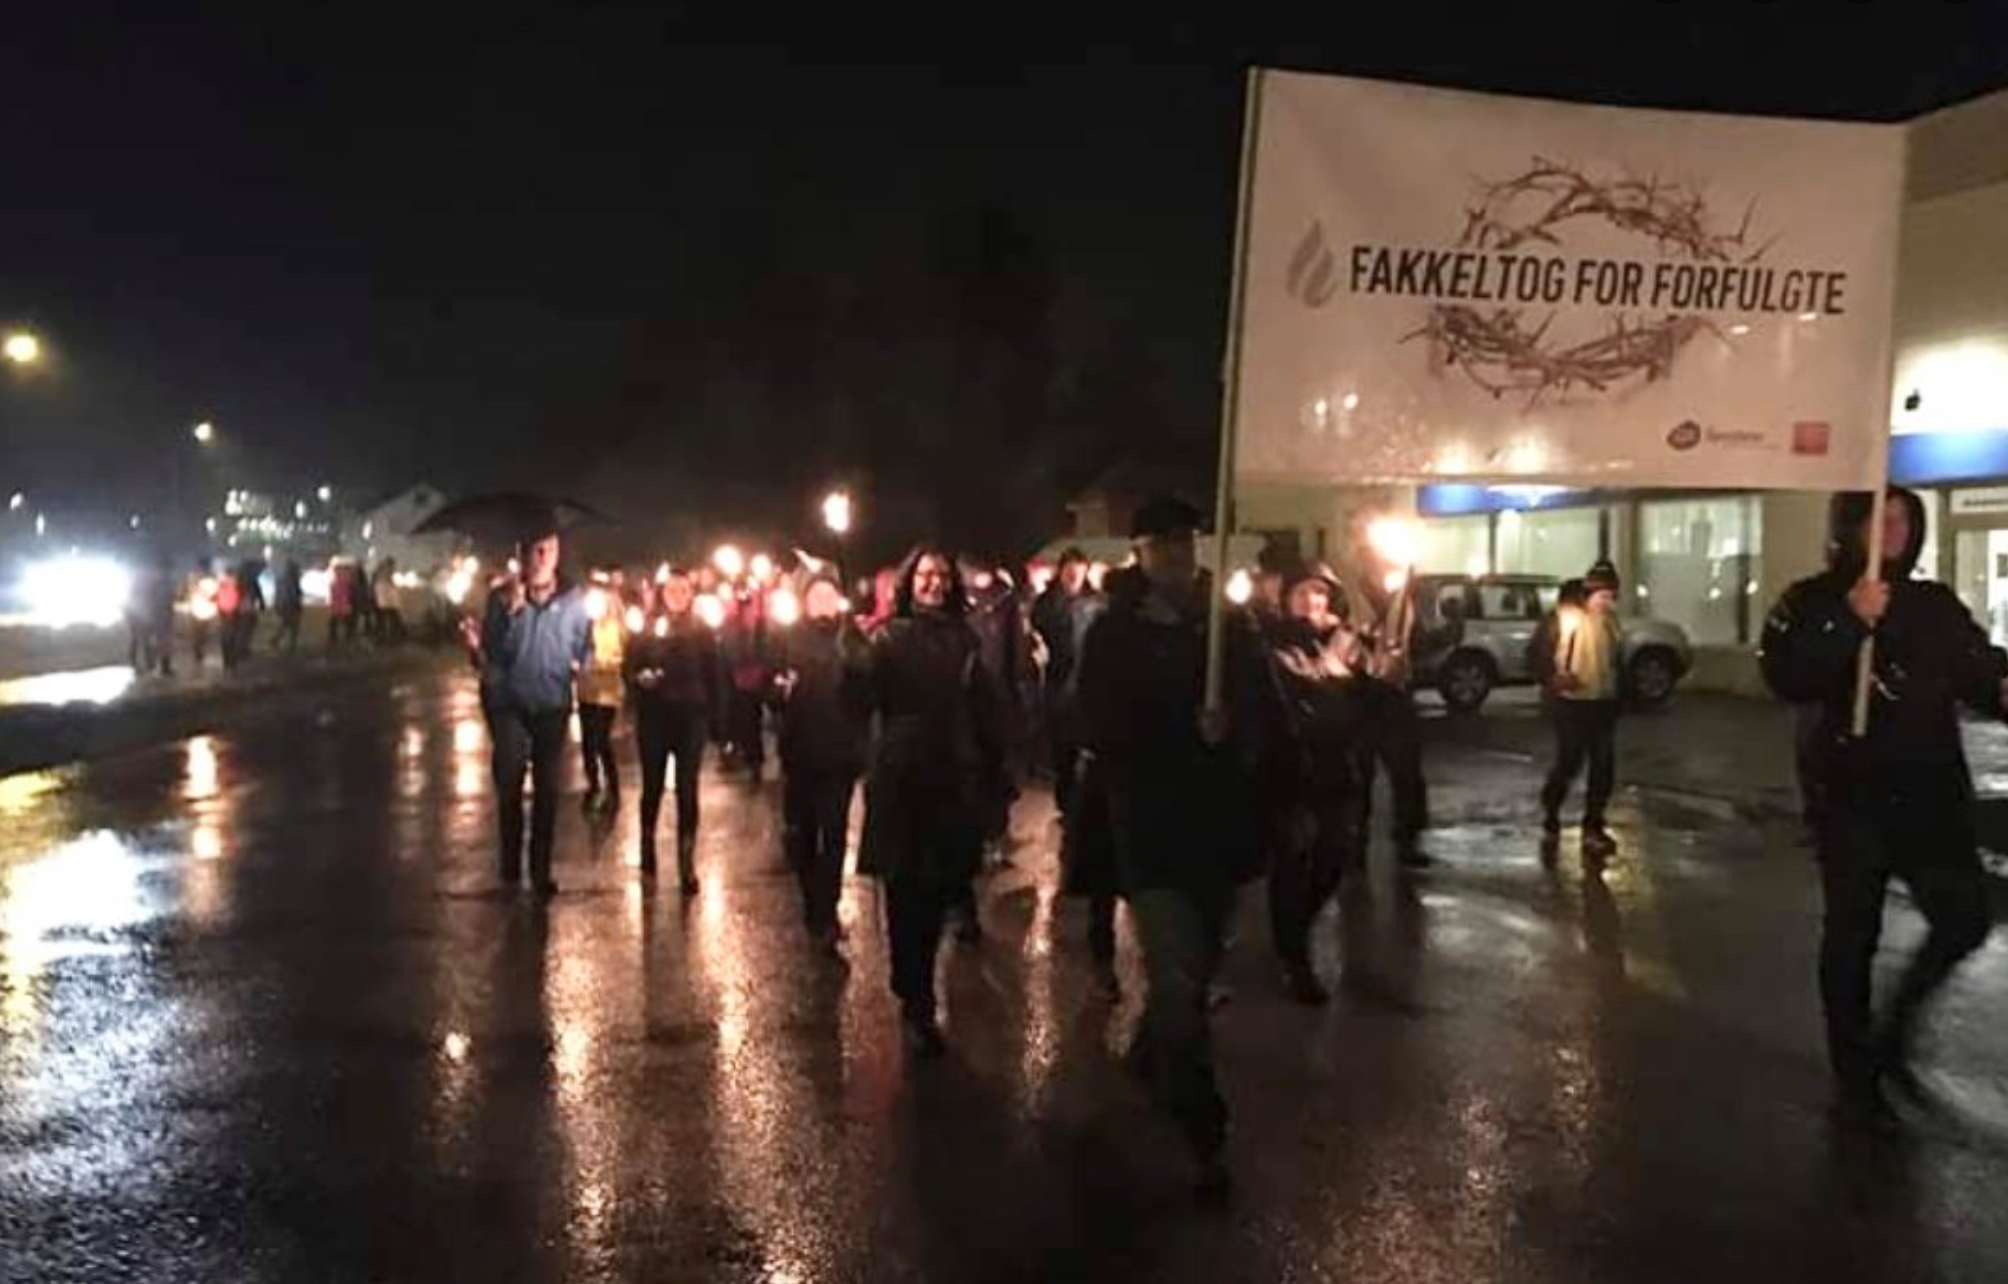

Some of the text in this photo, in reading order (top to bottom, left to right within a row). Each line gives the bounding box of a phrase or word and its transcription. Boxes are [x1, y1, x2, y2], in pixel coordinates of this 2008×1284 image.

[1350, 245, 1847, 315] FAKKELTOG FOR FORFULGTE
